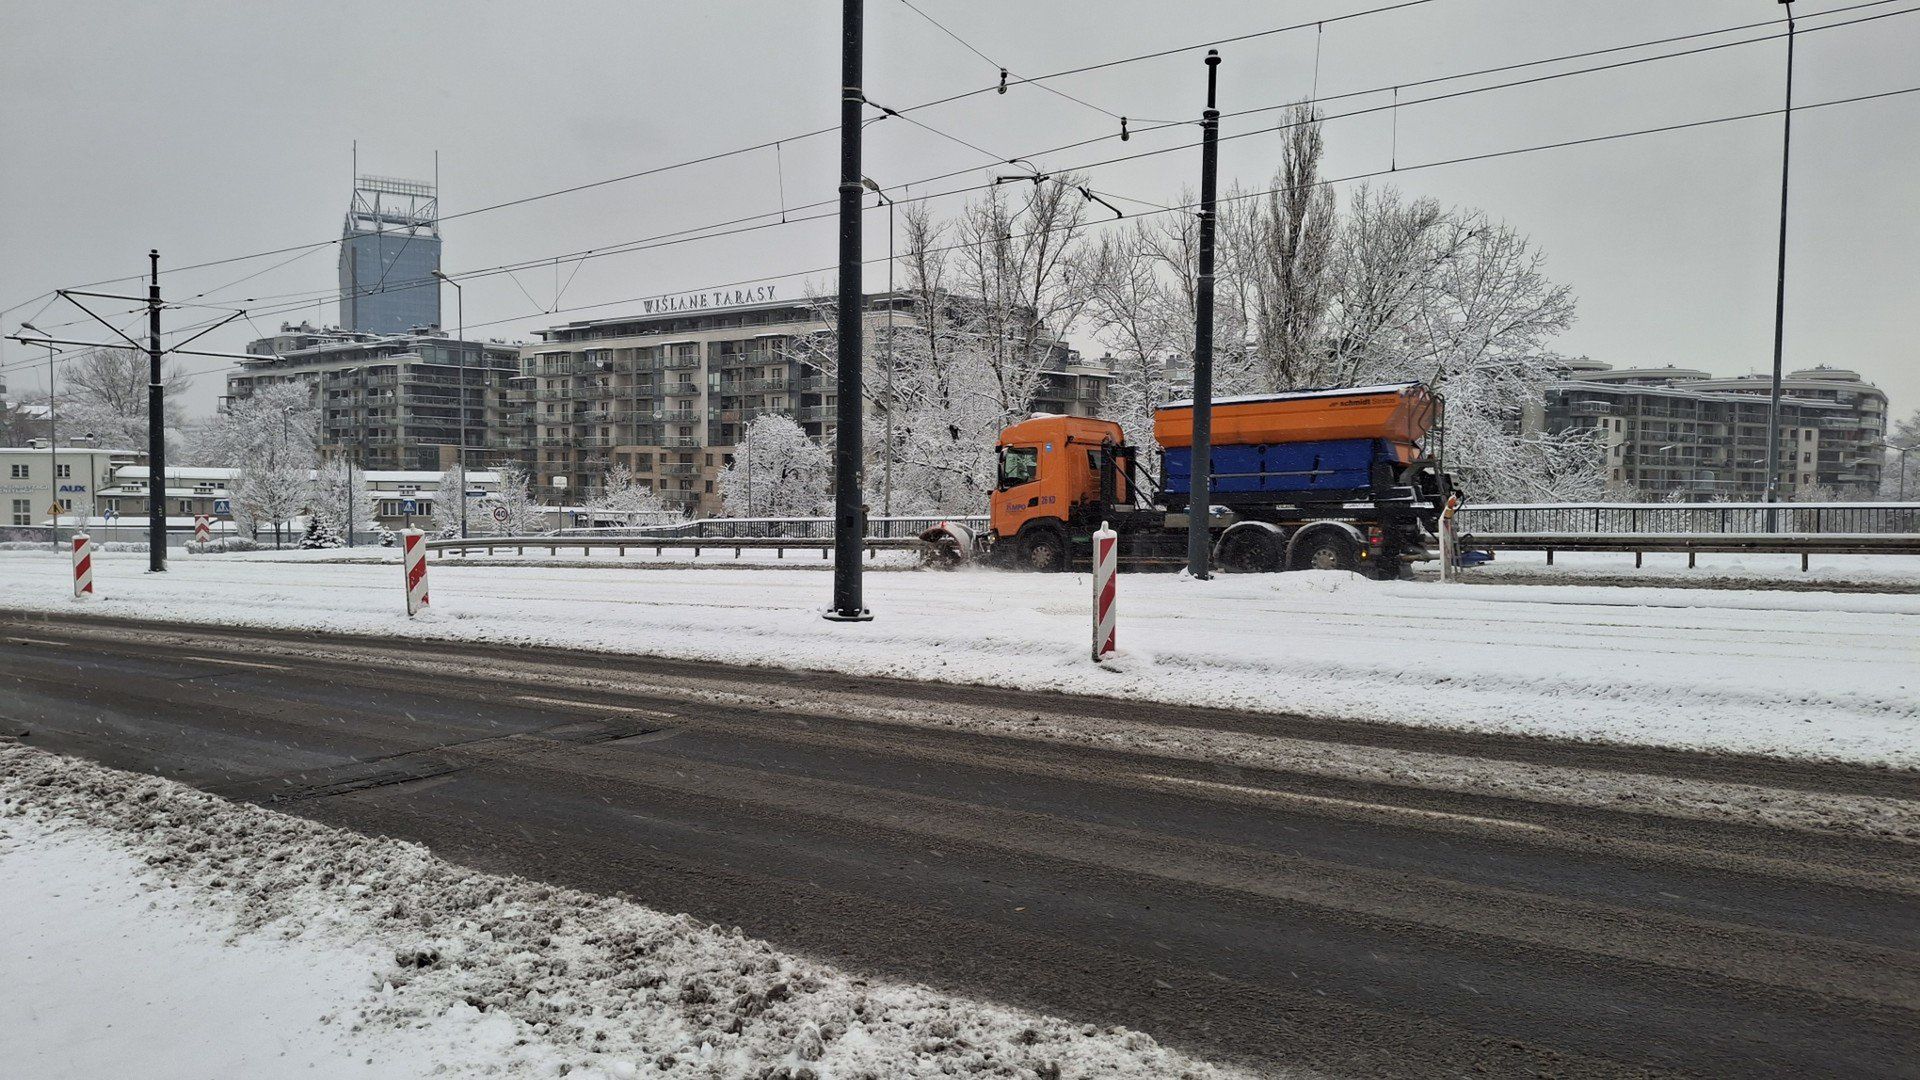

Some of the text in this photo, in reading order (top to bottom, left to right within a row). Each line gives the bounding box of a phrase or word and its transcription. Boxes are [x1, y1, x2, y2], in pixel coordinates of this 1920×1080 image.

[644, 286, 777, 313] WIŚLANE TARASY
[1340, 399, 1371, 407] schmidt
[59, 485, 87, 493] AUX
[495, 510, 505, 518] 40
